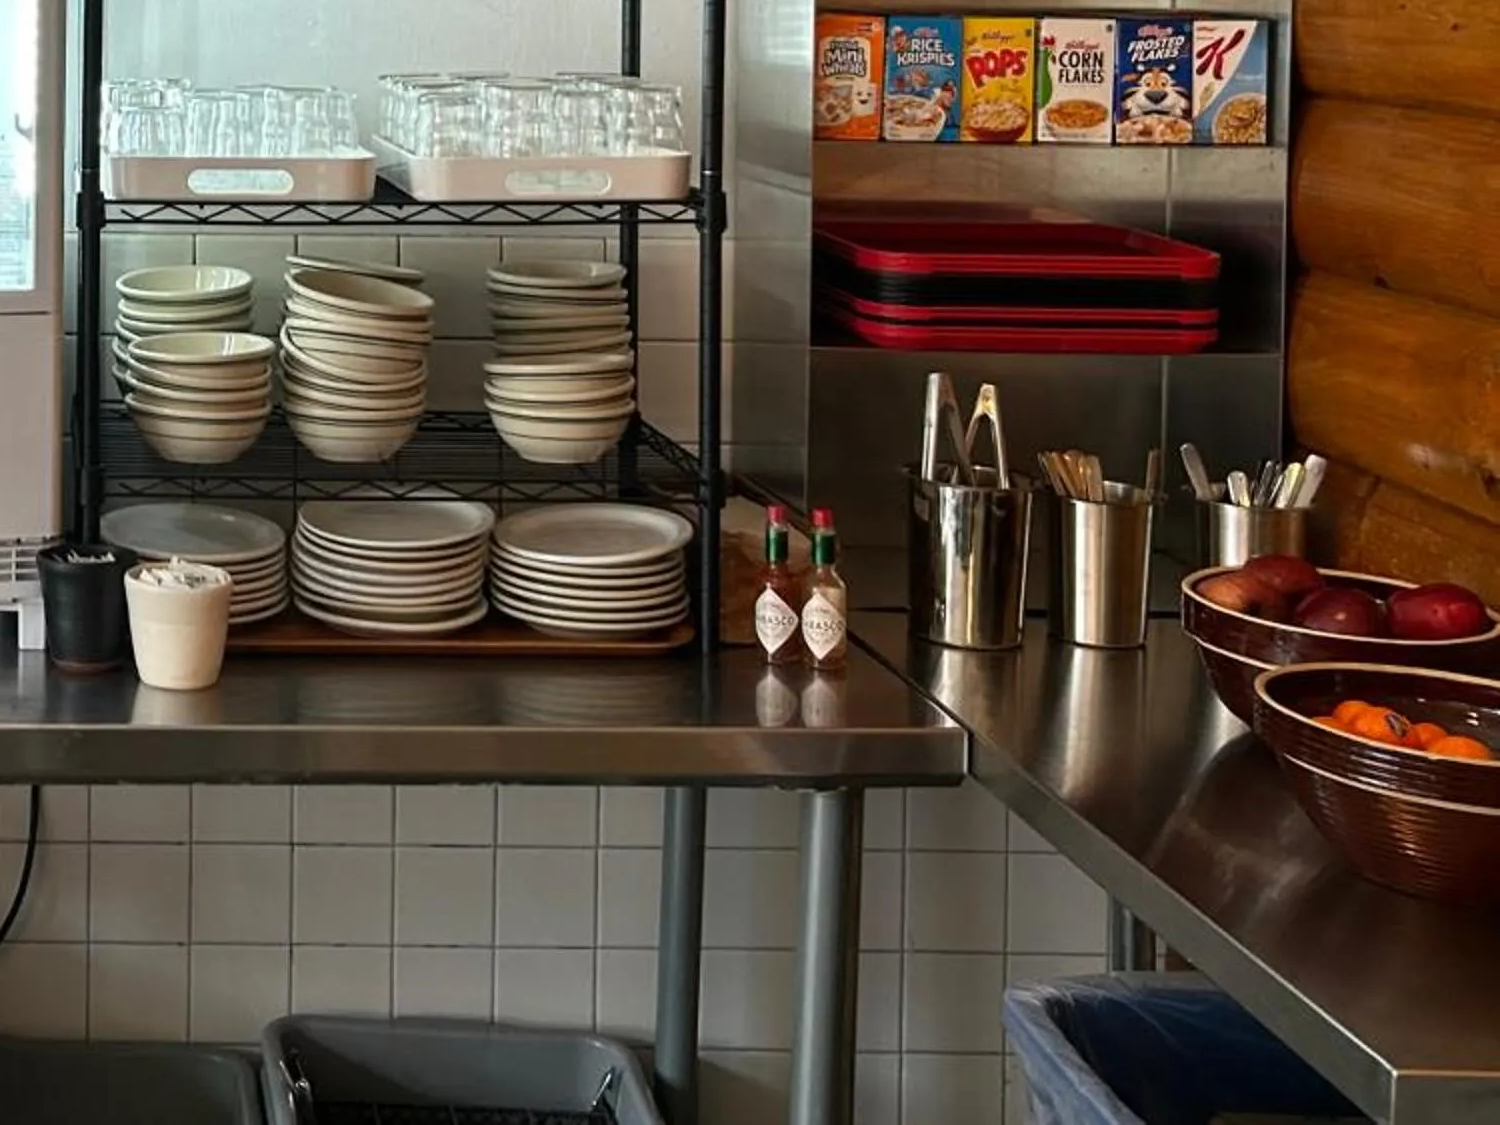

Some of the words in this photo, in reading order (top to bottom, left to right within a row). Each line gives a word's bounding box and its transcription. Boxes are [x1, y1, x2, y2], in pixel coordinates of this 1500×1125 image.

[910, 38, 943, 53] RICE
[1126, 35, 1186, 54] FROSTED
[825, 48, 864, 65] Mini
[896, 51, 955, 66] KRISPIES
[1058, 50, 1105, 69] CORN
[1131, 48, 1180, 63] FLAKES
[1195, 28, 1247, 81] K
[965, 48, 1029, 89] POPS
[1058, 68, 1105, 84] FLAKES
